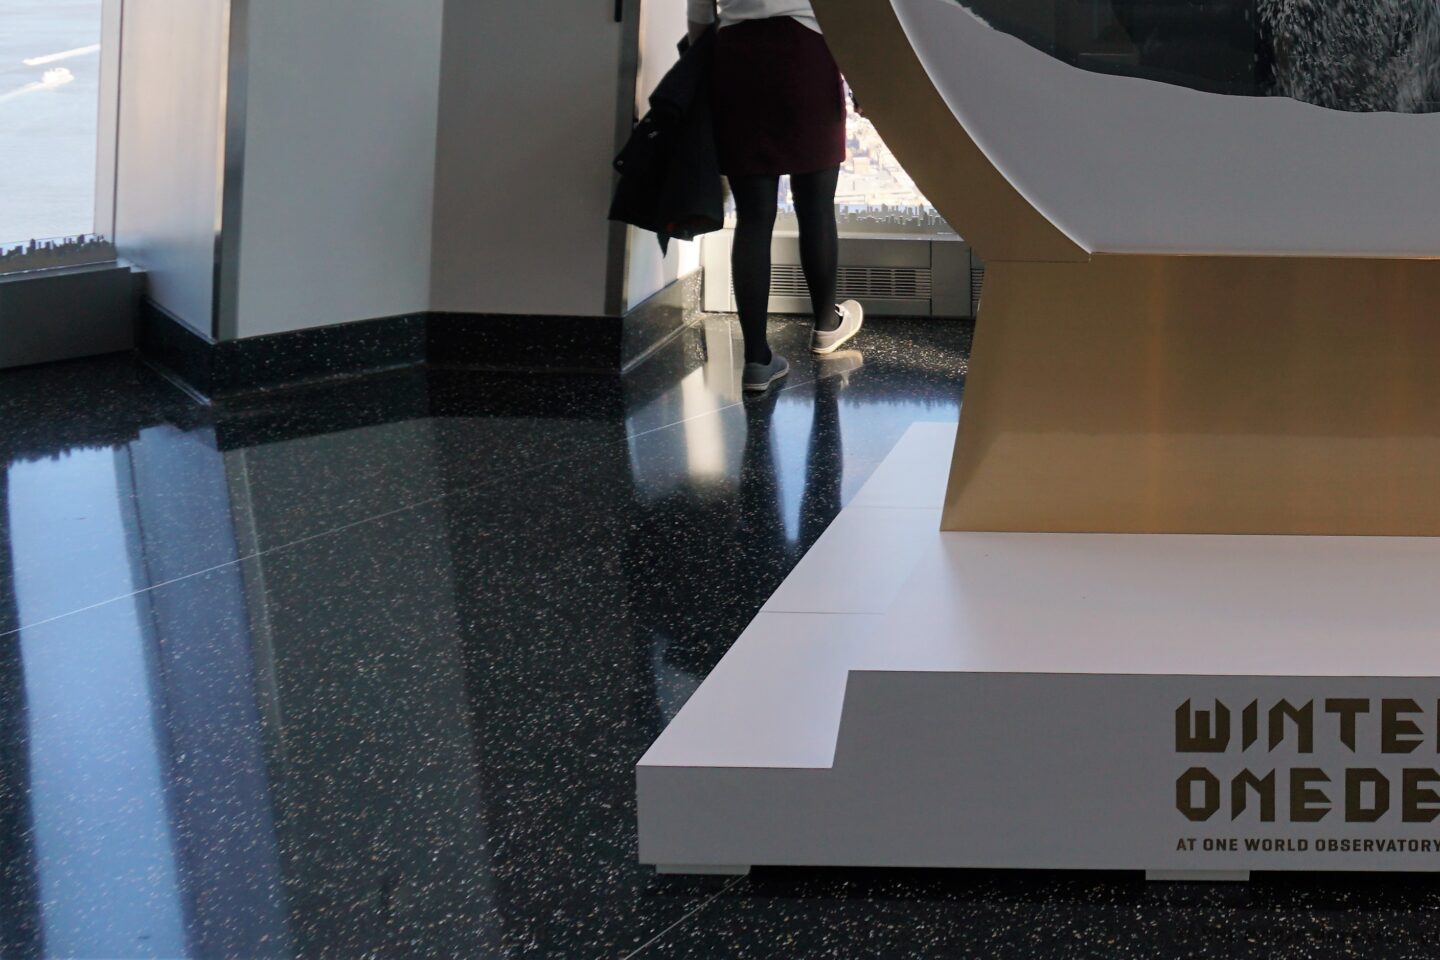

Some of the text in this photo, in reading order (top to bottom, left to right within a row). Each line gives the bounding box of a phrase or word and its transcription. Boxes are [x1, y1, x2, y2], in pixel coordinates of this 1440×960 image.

[1176, 838, 1198, 851] AT
[1203, 838, 1238, 851] ONE
[1245, 838, 1308, 852] WORLD
